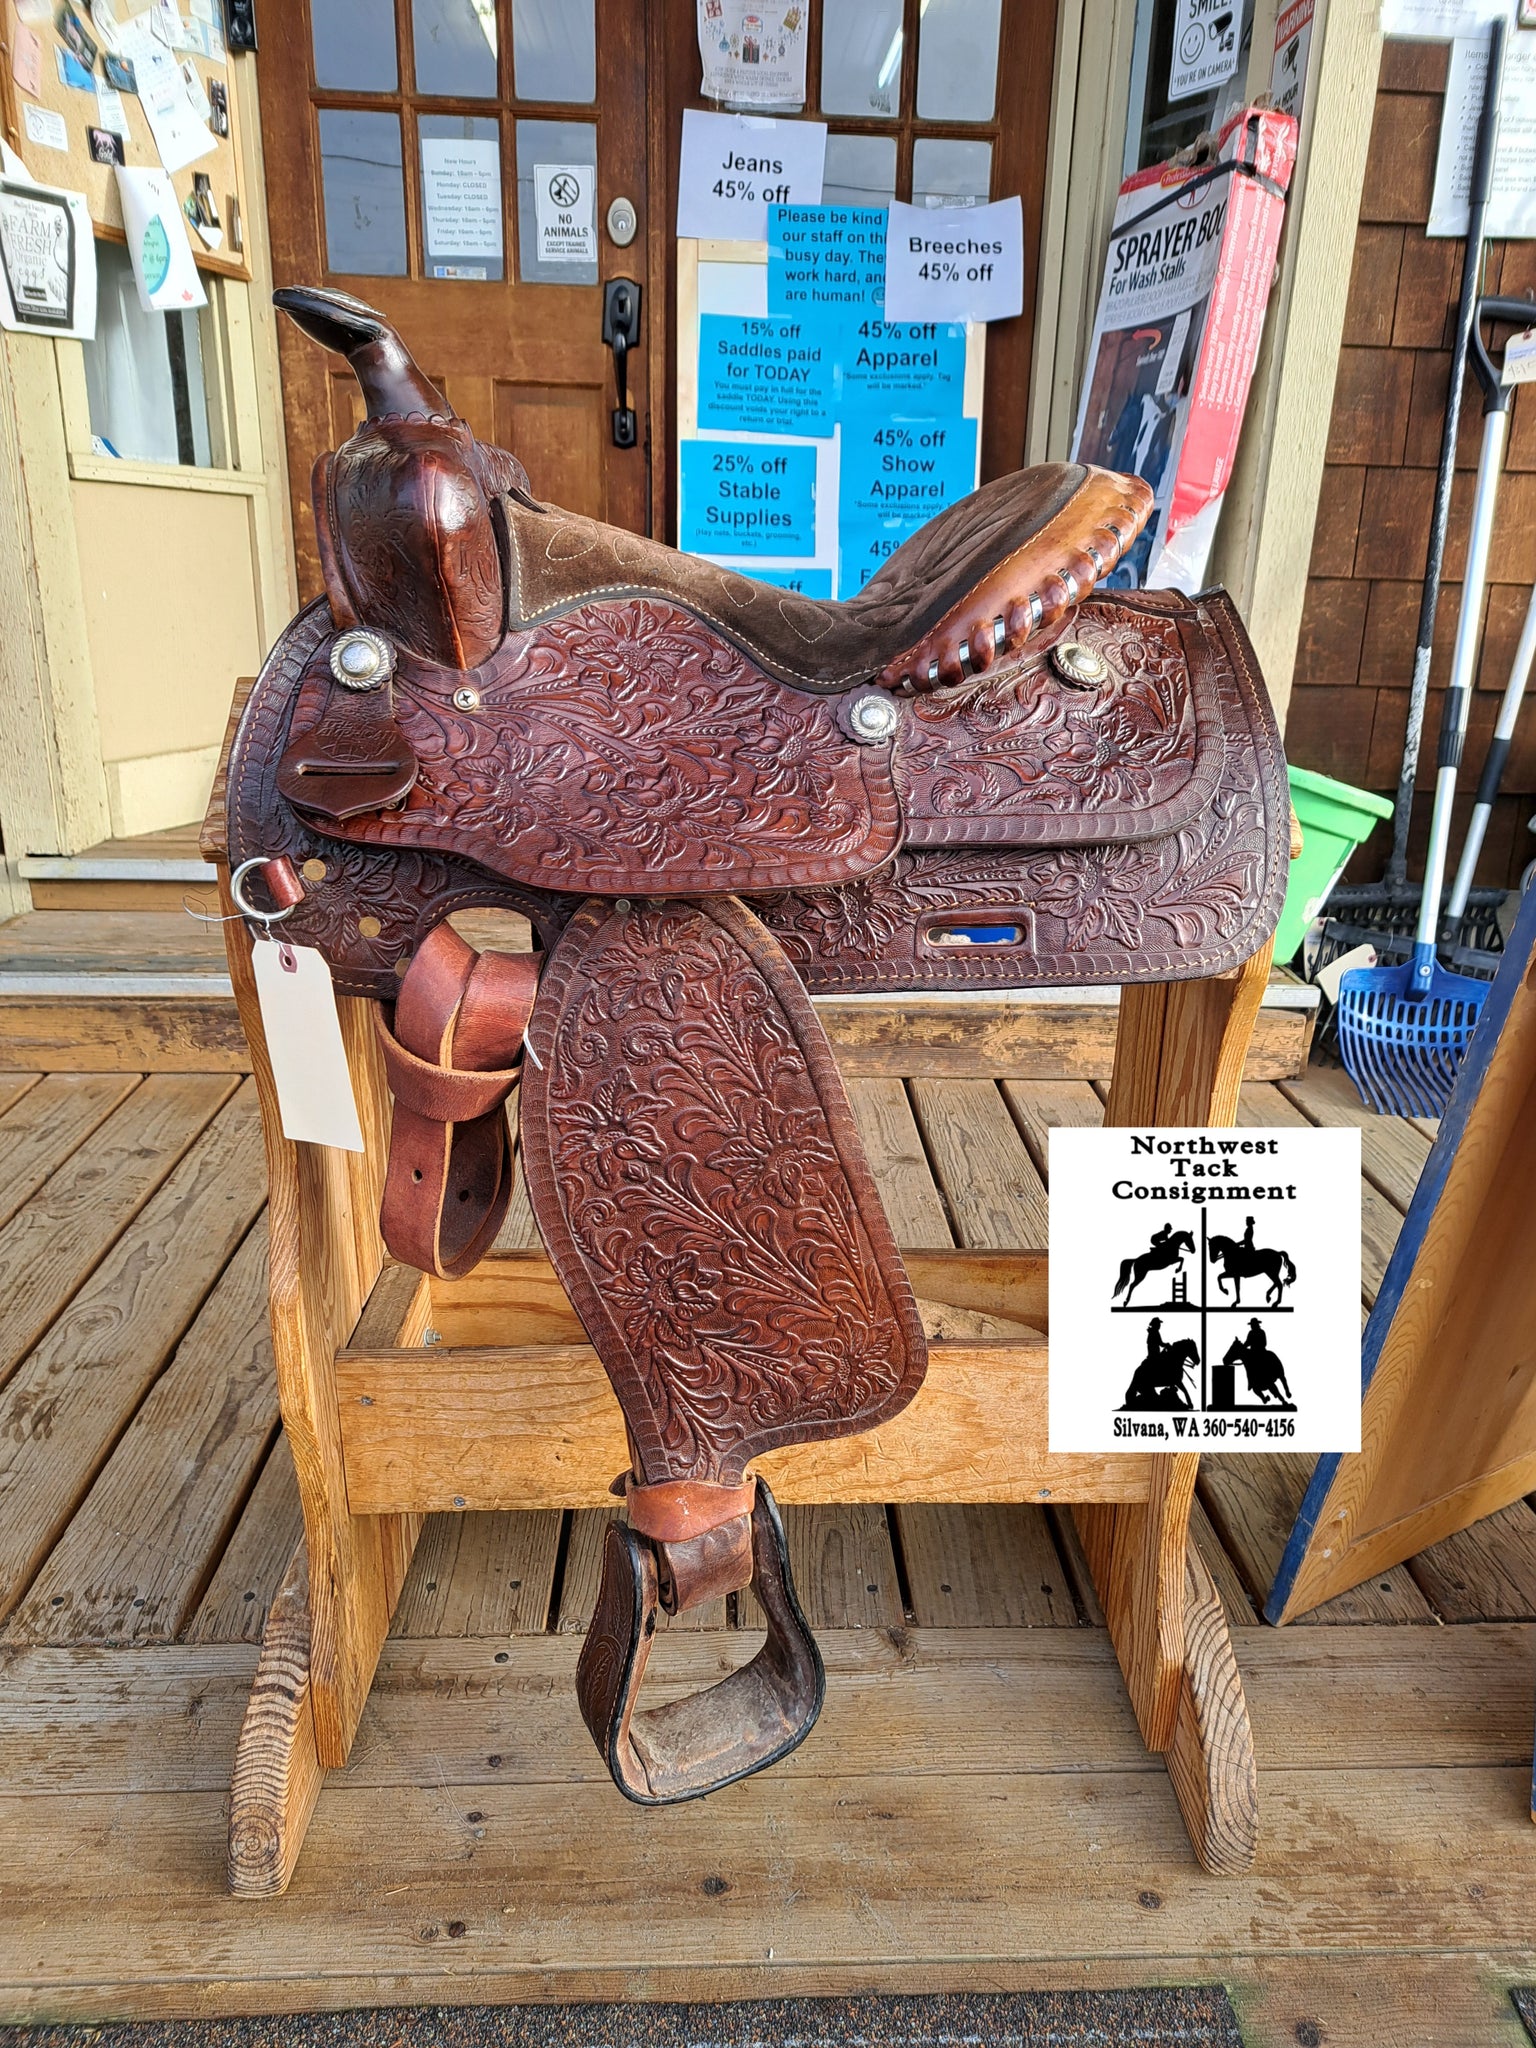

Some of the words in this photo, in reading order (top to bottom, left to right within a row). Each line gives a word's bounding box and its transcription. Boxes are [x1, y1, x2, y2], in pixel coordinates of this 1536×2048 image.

[1505, 53, 1531, 62] onger
[1198, 66, 1207, 81] ON
[1208, 58, 1231, 77] CAMERA
[722, 151, 783, 175] Jeans
[712, 178, 755, 201] 45%
[762, 185, 791, 204] off
[558, 213, 572, 225] NO
[778, 208, 826, 223] Please
[830, 210, 847, 224] be
[852, 211, 882, 226] kind
[1251, 201, 1261, 224] hose
[1259, 207, 1269, 225] and
[9, 214, 51, 238] FARM
[544, 226, 589, 238] ANIMALS
[10, 233, 51, 256] FRESH
[782, 231, 807, 242] our
[811, 230, 844, 243] staff
[847, 233, 865, 244] on
[870, 231, 887, 245] thi
[909, 236, 1003, 254] Breeches
[1113, 217, 1197, 274] SPRAYER
[1225, 229, 1238, 262] extend
[1247, 223, 1259, 251] keeps
[1255, 225, 1267, 257] horses
[15, 249, 47, 266] Organic
[785, 248, 820, 266] busy
[824, 250, 853, 266] day.
[858, 250, 885, 264] The
[785, 268, 820, 282] work
[824, 269, 860, 285] hard,
[918, 262, 959, 281] 45%
[967, 263, 994, 282] off
[1109, 276, 1128, 297] For
[1128, 270, 1157, 293] Wash
[1157, 257, 1187, 285] Stalls
[1223, 261, 1232, 275] to
[1241, 258, 1252, 281] post
[1247, 257, 1262, 296] bathing
[1217, 274, 1230, 303] ability
[1239, 280, 1247, 291] or
[785, 290, 807, 301] are
[812, 289, 865, 303] human!
[1234, 289, 1244, 311] wall
[1244, 294, 1253, 309] for
[1213, 302, 1224, 325] with
[742, 321, 774, 337] 15%
[779, 324, 801, 339] off
[858, 320, 902, 339] 45%
[909, 322, 938, 340] off
[1229, 311, 1241, 340] sturdy
[718, 340, 782, 359] Saddles
[787, 346, 821, 364] paid
[856, 347, 938, 371] Apparel
[1214, 340, 1226, 369] install
[1227, 339, 1239, 359] any
[727, 362, 750, 378] for
[754, 364, 811, 382] TODAY
[1224, 357, 1232, 369] to
[869, 372, 911, 381] exclusions
[1211, 368, 1220, 381] to
[714, 380, 730, 389] You
[731, 382, 753, 391] must
[754, 384, 771, 393] pay
[771, 385, 779, 393] in
[781, 385, 795, 394] full
[796, 386, 808, 395] for
[809, 387, 822, 396] the
[867, 382, 881, 390] will
[881, 382, 892, 390] be
[1207, 380, 1219, 402] Easy
[1217, 368, 1229, 403] Mounts
[708, 402, 744, 411] discount
[746, 403, 768, 413] voids
[770, 406, 788, 416] your
[790, 407, 810, 418] right
[811, 408, 820, 416] to
[716, 393, 744, 401] saddle
[777, 397, 801, 407] Using
[803, 397, 819, 406] this
[739, 414, 765, 423] return
[765, 416, 775, 424] or
[873, 429, 913, 447] 45%
[919, 430, 947, 447] off
[712, 454, 754, 473] 25%
[761, 457, 788, 475] off
[882, 454, 936, 472] Show
[718, 480, 781, 500] Stable
[870, 479, 945, 500] Apparel
[878, 511, 890, 519] will
[892, 511, 901, 519] be
[880, 501, 921, 510] exclusions
[706, 505, 792, 529] Supplies
